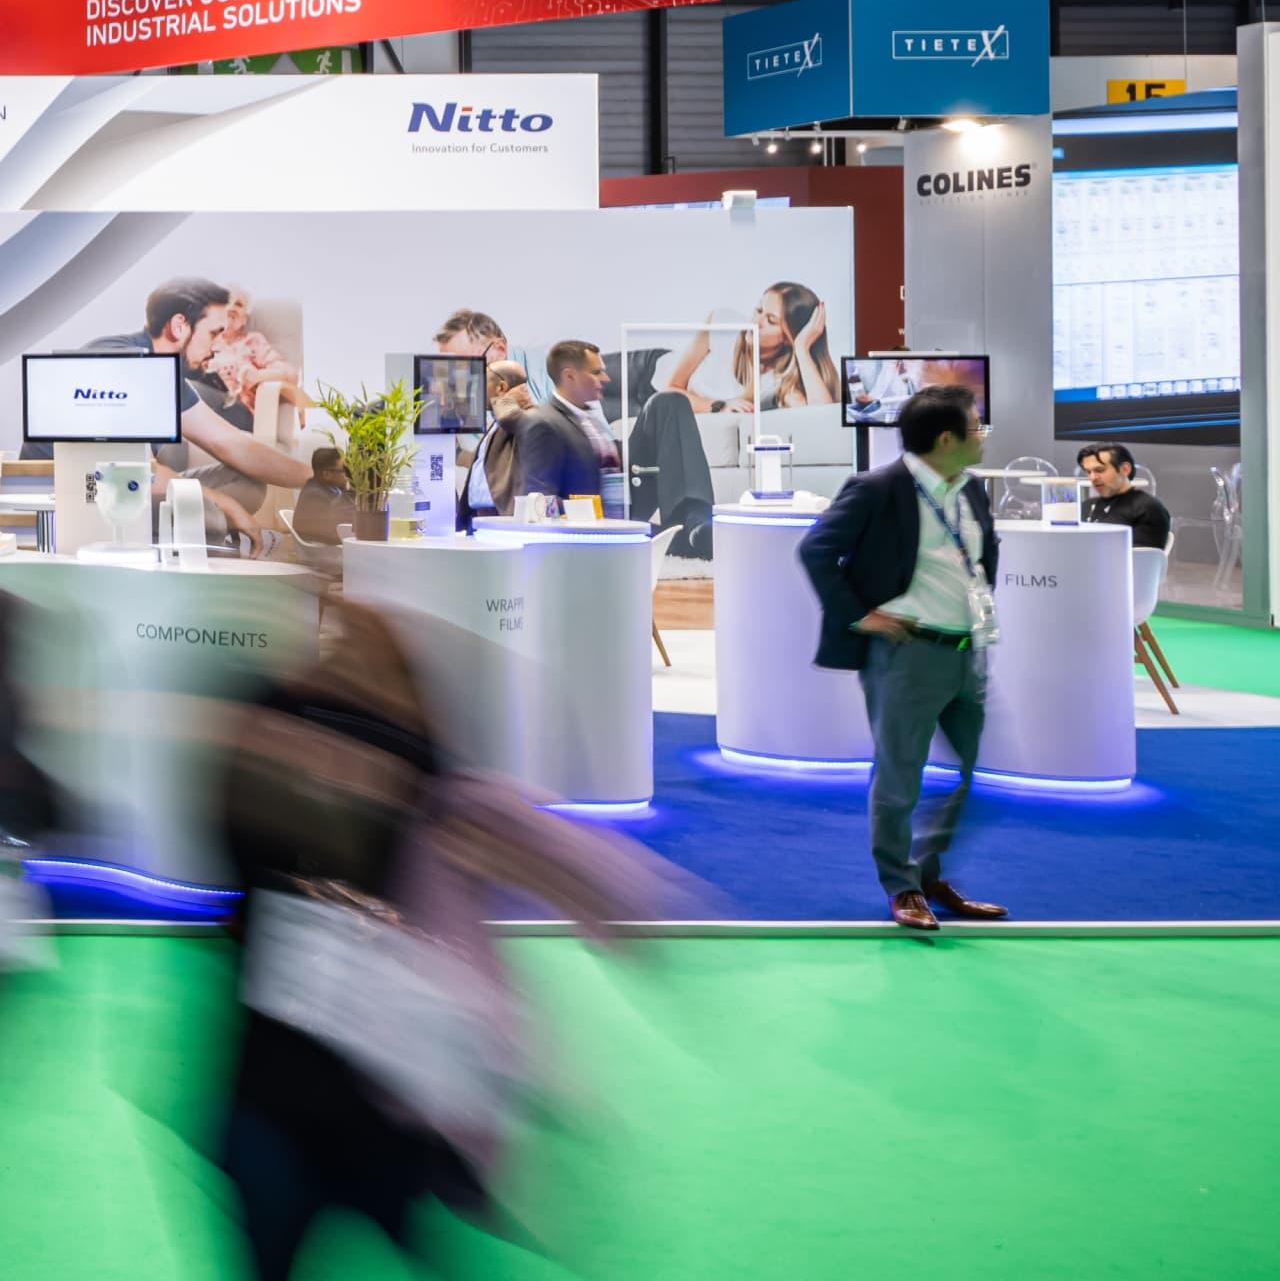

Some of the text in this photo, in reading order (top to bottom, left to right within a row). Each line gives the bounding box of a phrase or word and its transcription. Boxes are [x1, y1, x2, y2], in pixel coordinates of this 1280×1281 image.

[85, 11, 217, 47] INDUSTRIAL
[744, 32, 821, 79] TIETEX
[904, 24, 1006, 69] TIETEX
[407, 102, 554, 133] Nitto
[412, 142, 549, 154] Innovation for Customers
[917, 164, 1031, 196] COLINES
[73, 388, 127, 400] Nitto
[1005, 573, 1058, 588] FILMS
[136, 623, 268, 648] COMPONENTS
